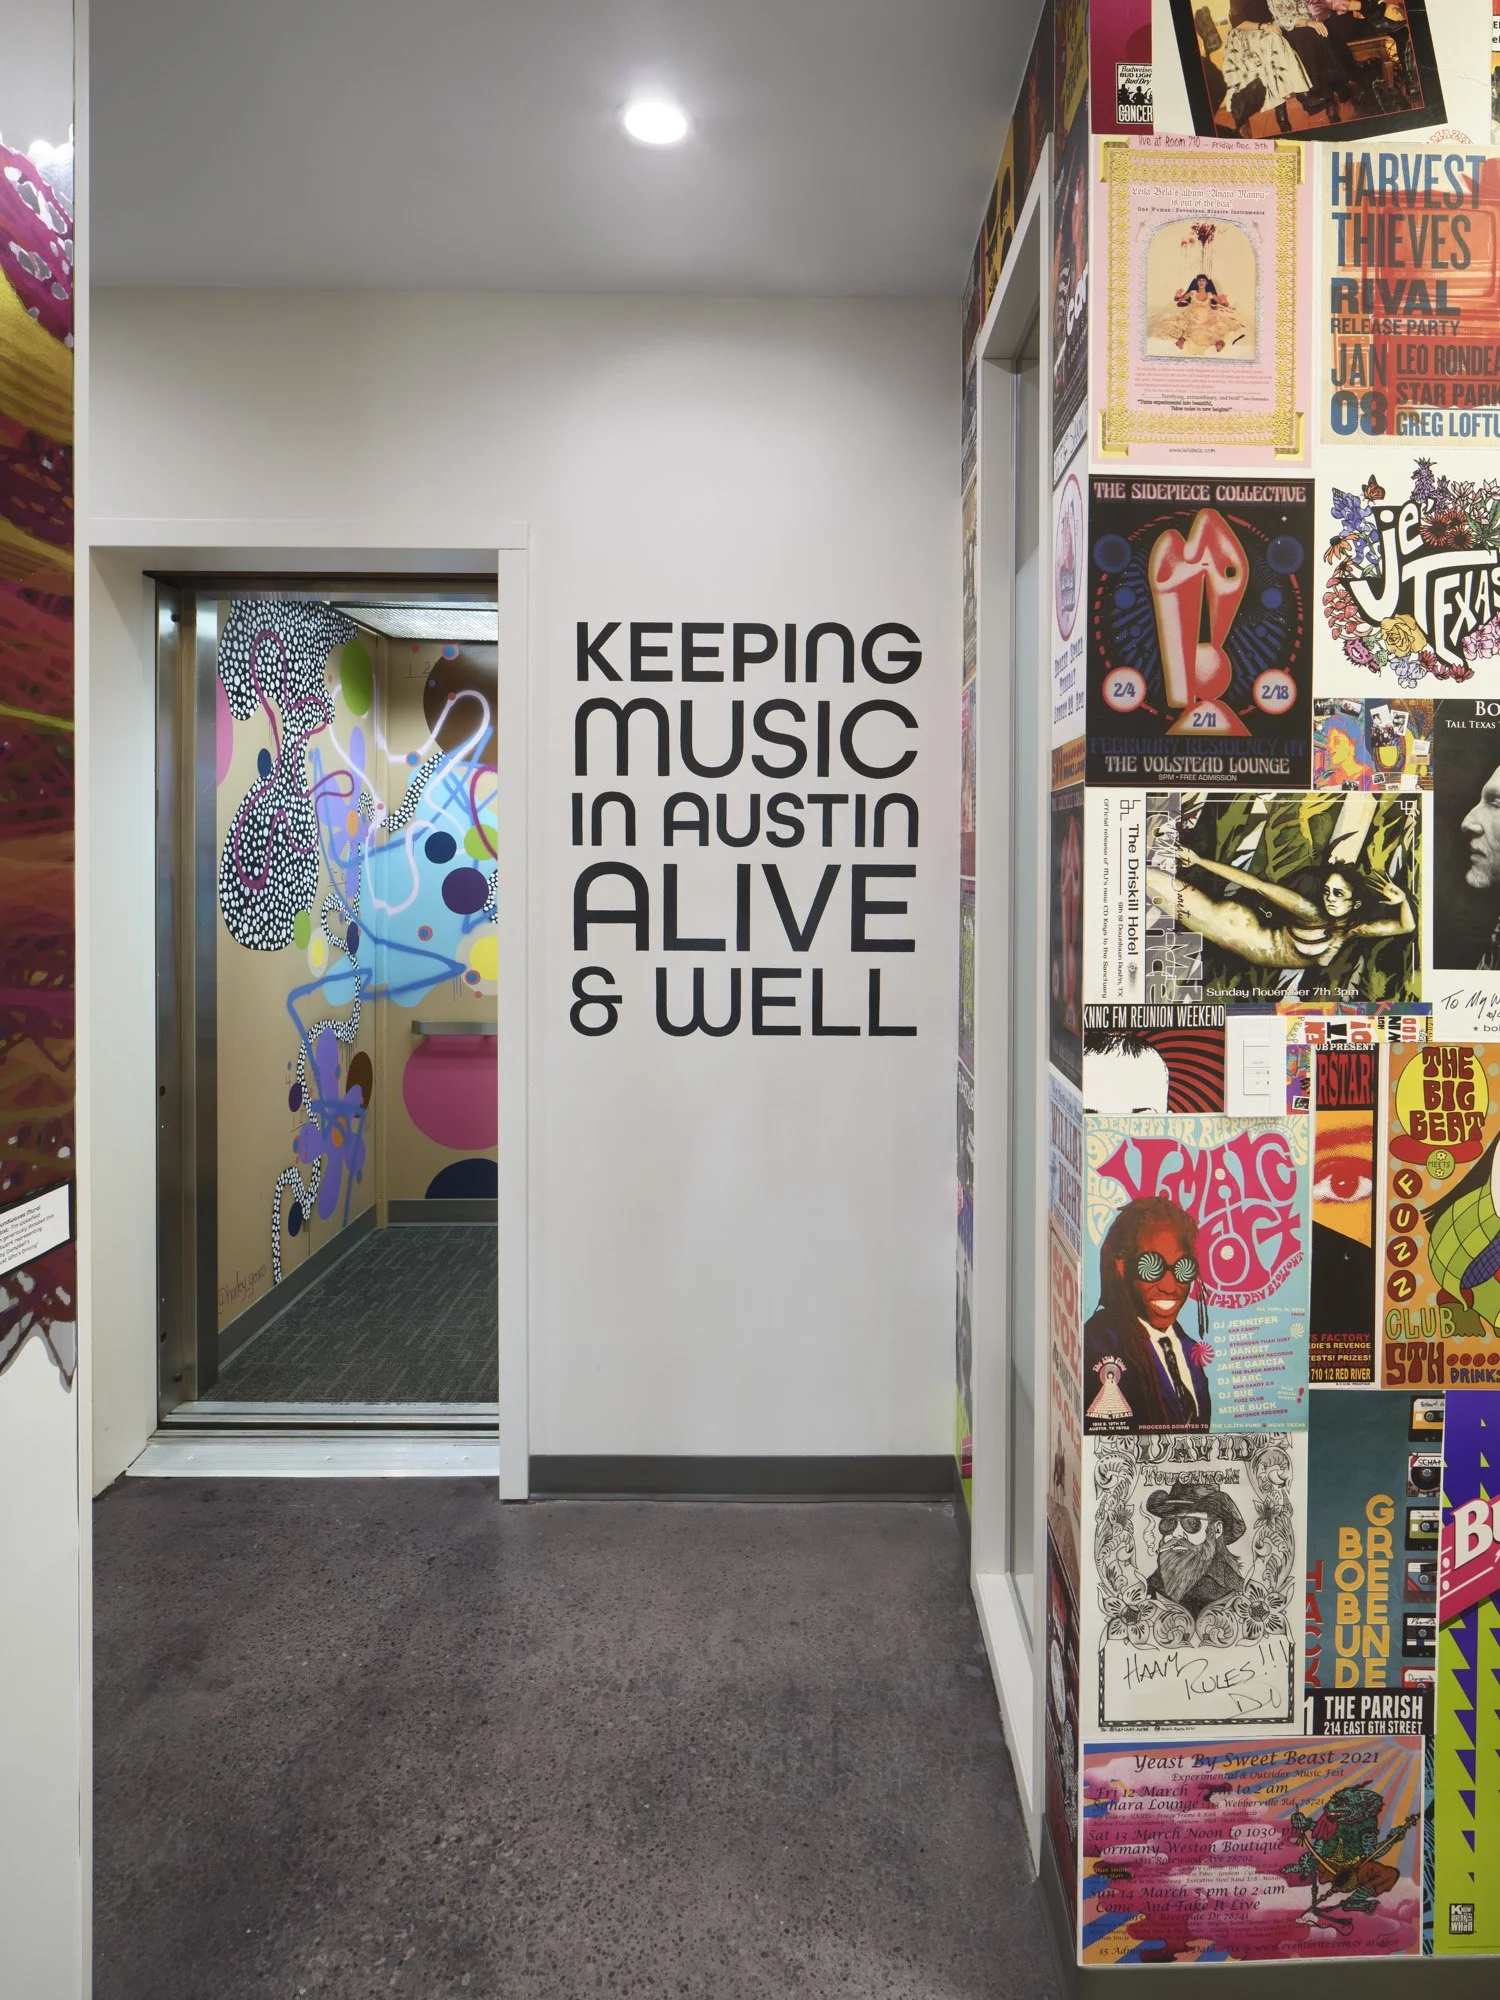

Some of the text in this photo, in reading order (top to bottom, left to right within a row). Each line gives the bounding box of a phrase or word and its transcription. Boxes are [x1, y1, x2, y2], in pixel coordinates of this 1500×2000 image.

[1154, 137, 1161, 146] at
[1165, 136, 1185, 148] Room
[1188, 136, 1200, 148] 710
[1254, 142, 1269, 150] 5th
[1331, 151, 1487, 210] HARVEST
[1331, 212, 1472, 271] THIEVES
[1330, 277, 1462, 317] RIVAL
[1330, 318, 1461, 337] RELEASE PARTY
[1331, 343, 1388, 387] JAN
[1396, 344, 1429, 375] LEO
[1396, 382, 1447, 406] STAR
[1330, 390, 1389, 437] 08
[1395, 411, 1444, 437] GREG
[1093, 482, 1307, 503] THE SIDEPIECE COLLECTIVE
[576, 621, 923, 685] KEEPING
[1113, 683, 1137, 698] 2/4
[1261, 685, 1290, 701] 2/18
[1192, 712, 1217, 728] 2/11
[1445, 719, 1496, 730] TALL TEXAS
[574, 697, 919, 779] MUSIC
[1091, 736, 1180, 755] FEBRUARY
[1186, 737, 1277, 756] RESIDENCY
[1104, 755, 1137, 773] THE
[1144, 756, 1223, 774] VOLSTEAD
[1229, 757, 1290, 774] LOUNGE
[1158, 773, 1237, 782] 9PM FREE ADMISSION
[572, 791, 919, 848] IN AUSTIN
[1128, 823, 1139, 956] The Driskill Hotel
[573, 861, 917, 953] ALIVE
[1102, 905, 1109, 917] CD
[569, 966, 918, 1037] & WELL
[1206, 986, 1359, 1000] Sunday November 7th 3pm
[1441, 989, 1488, 1019] To My
[1083, 1005, 1225, 1029] KNNC FM REUNION WEEKEND
[1330, 1043, 1376, 1051] PRESENT
[1422, 1047, 1475, 1079] THE
[1423, 1080, 1476, 1111] BIG
[1101, 1117, 1166, 1137] BENEFIT
[1168, 1118, 1195, 1146] FOR
[1409, 1110, 1486, 1142] BEAT
[1427, 1160, 1451, 1168] MEETS
[1392, 1173, 1414, 1298] FUZZ
[1213, 1316, 1278, 1329] DJ JENNIFER
[1385, 1307, 1456, 1339] CLUB
[1214, 1332, 1254, 1344] DJ DIRT
[1321, 1333, 1370, 1342] FACTORY
[1215, 1345, 1270, 1357] DJ DANGIT
[1216, 1357, 1285, 1372] JAKE GARCIA
[1385, 1341, 1446, 1386] 5TH
[1217, 1373, 1263, 1385] DJ MARC
[1311, 1368, 1371, 1380] 710 RED RIVER
[1218, 1389, 1254, 1400] DJ SUE
[1218, 1401, 1277, 1414] MIKE BUCK
[1136, 1434, 1256, 1464] DAVID
[1324, 1695, 1424, 1720] THE PARISH
[1324, 1720, 1423, 1735] 214 EAST 6TH STREET
[1134, 1750, 1379, 1773] Yeast By Sweet Beast 2021
[1171, 1768, 1344, 1782] Experimental Outsider Music Fest
[1096, 1783, 1288, 1798] Fri 12 March to 2 am
[1093, 1799, 1278, 1813] Sahara Lounge Webberville
[1087, 1827, 1276, 1842] Sat 13 March Noon to 1030
[1093, 1840, 1285, 1857] Normany Weston Boutique
[1205, 1855, 1253, 1863] Ave 78702
[1089, 1884, 1286, 1899] Sun 14 March 5 pm to 2 am
[1095, 1898, 1260, 1913] Come And Take It Live
[1207, 1912, 1249, 1921] Dr 78741
